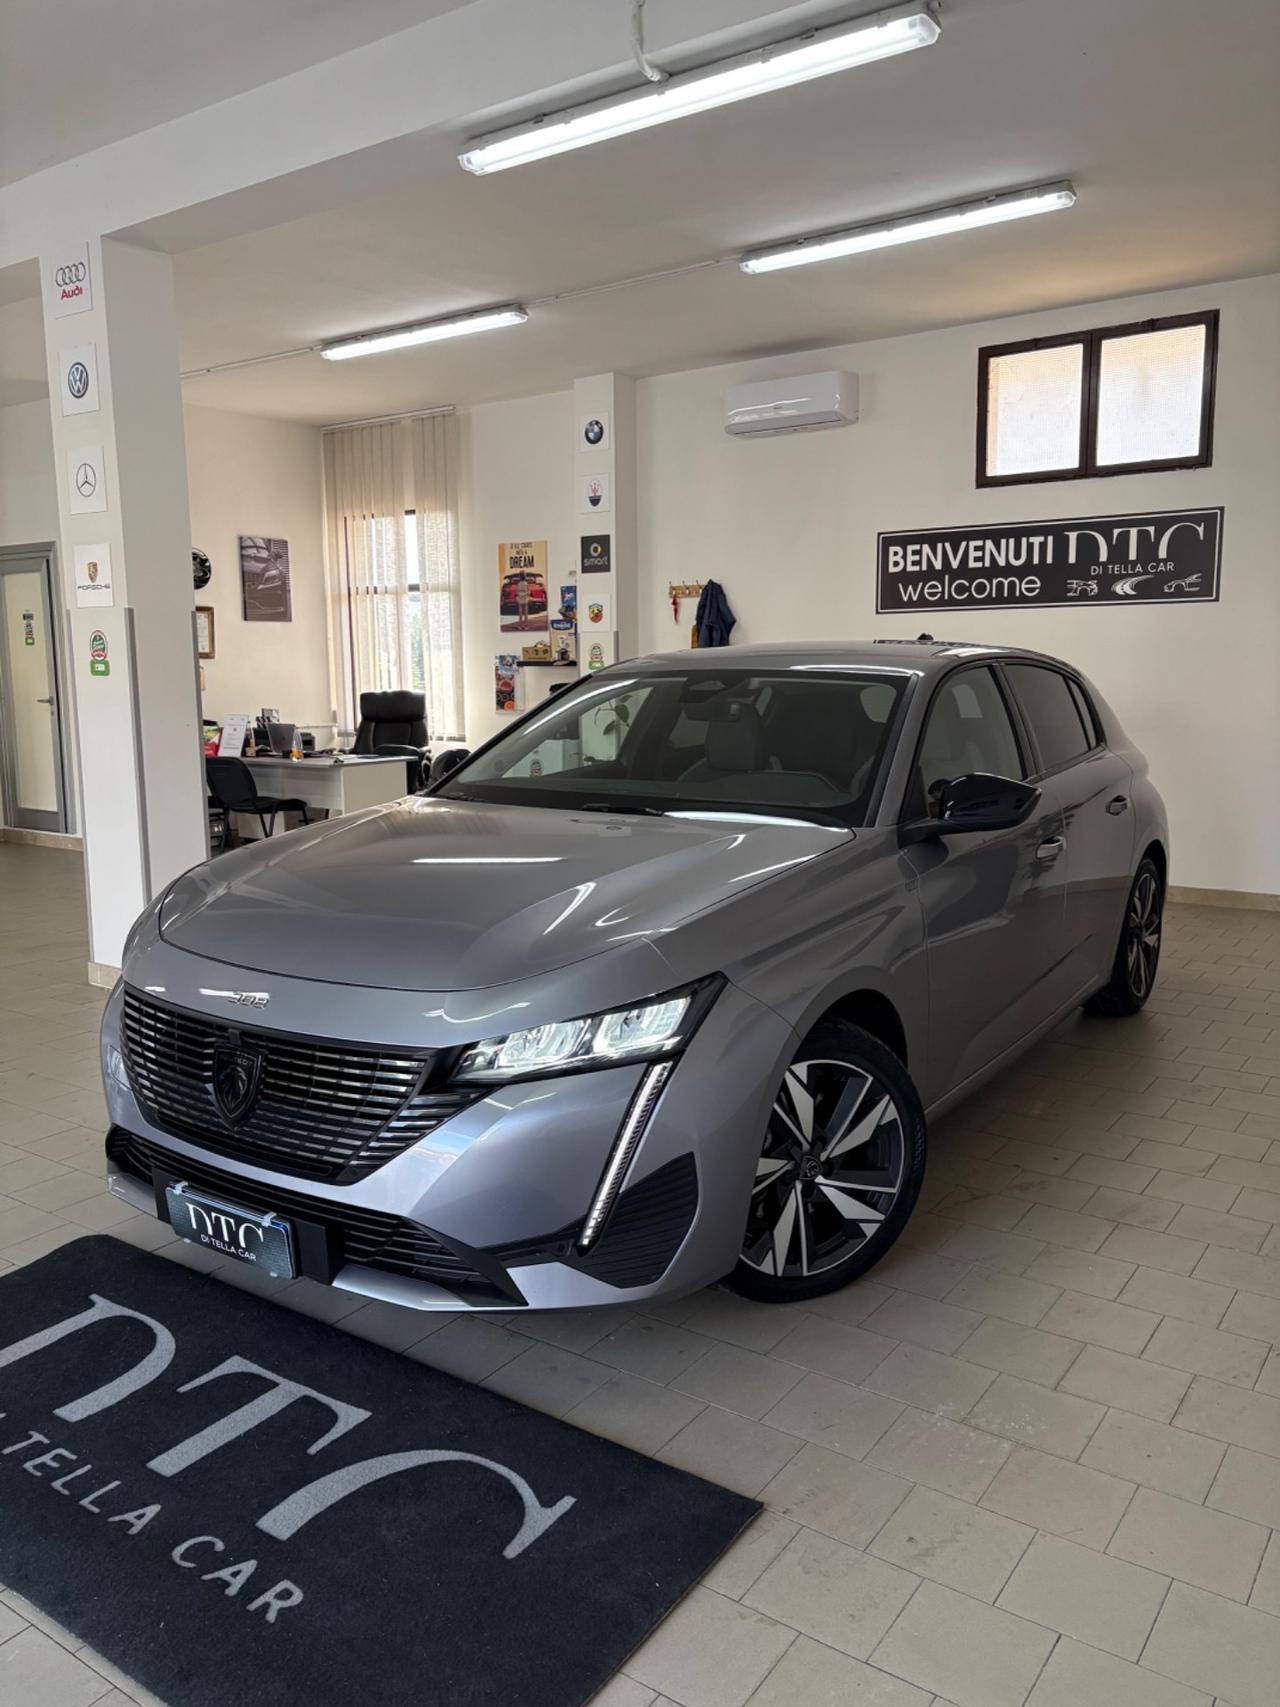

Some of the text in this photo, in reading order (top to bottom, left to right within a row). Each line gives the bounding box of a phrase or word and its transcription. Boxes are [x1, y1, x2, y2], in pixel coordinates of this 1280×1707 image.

[60, 285, 83, 300] Audi
[584, 556, 609, 567] smart
[888, 535, 1054, 573] BENVENUTI
[509, 555, 535, 569] DREAM
[1091, 561, 1175, 575] DI TELLA CAR
[77, 583, 111, 591] PORSCHE
[898, 574, 1041, 602] welcome
[200, 1234, 257, 1262] DI TELLA CAR
[1, 1430, 305, 1623] TELLA CAR
